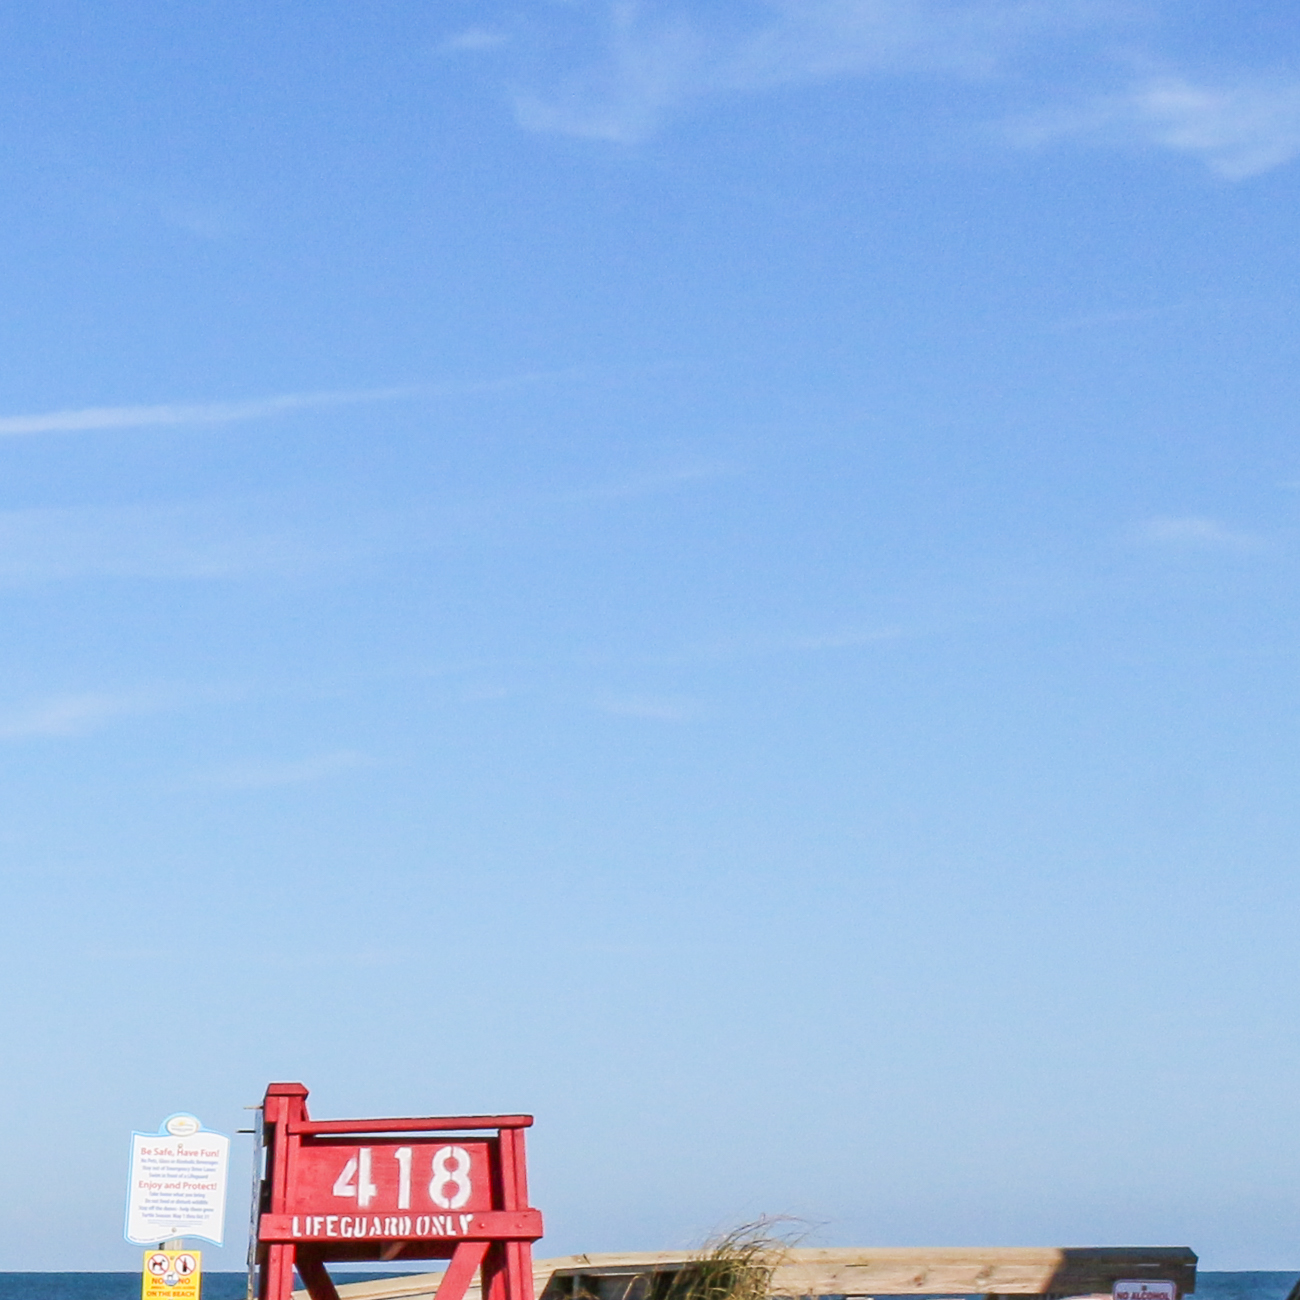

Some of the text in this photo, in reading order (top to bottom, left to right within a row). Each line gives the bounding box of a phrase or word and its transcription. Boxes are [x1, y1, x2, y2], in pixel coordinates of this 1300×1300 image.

[154, 1148, 175, 1156] Safe,
[333, 1146, 471, 1210] 418
[139, 1181, 162, 1190] Enjoy
[183, 1182, 217, 1190] Protect!
[292, 1214, 473, 1237] LIFEGUARD ONLY
[1132, 1292, 1169, 1300] ALCOHOL
